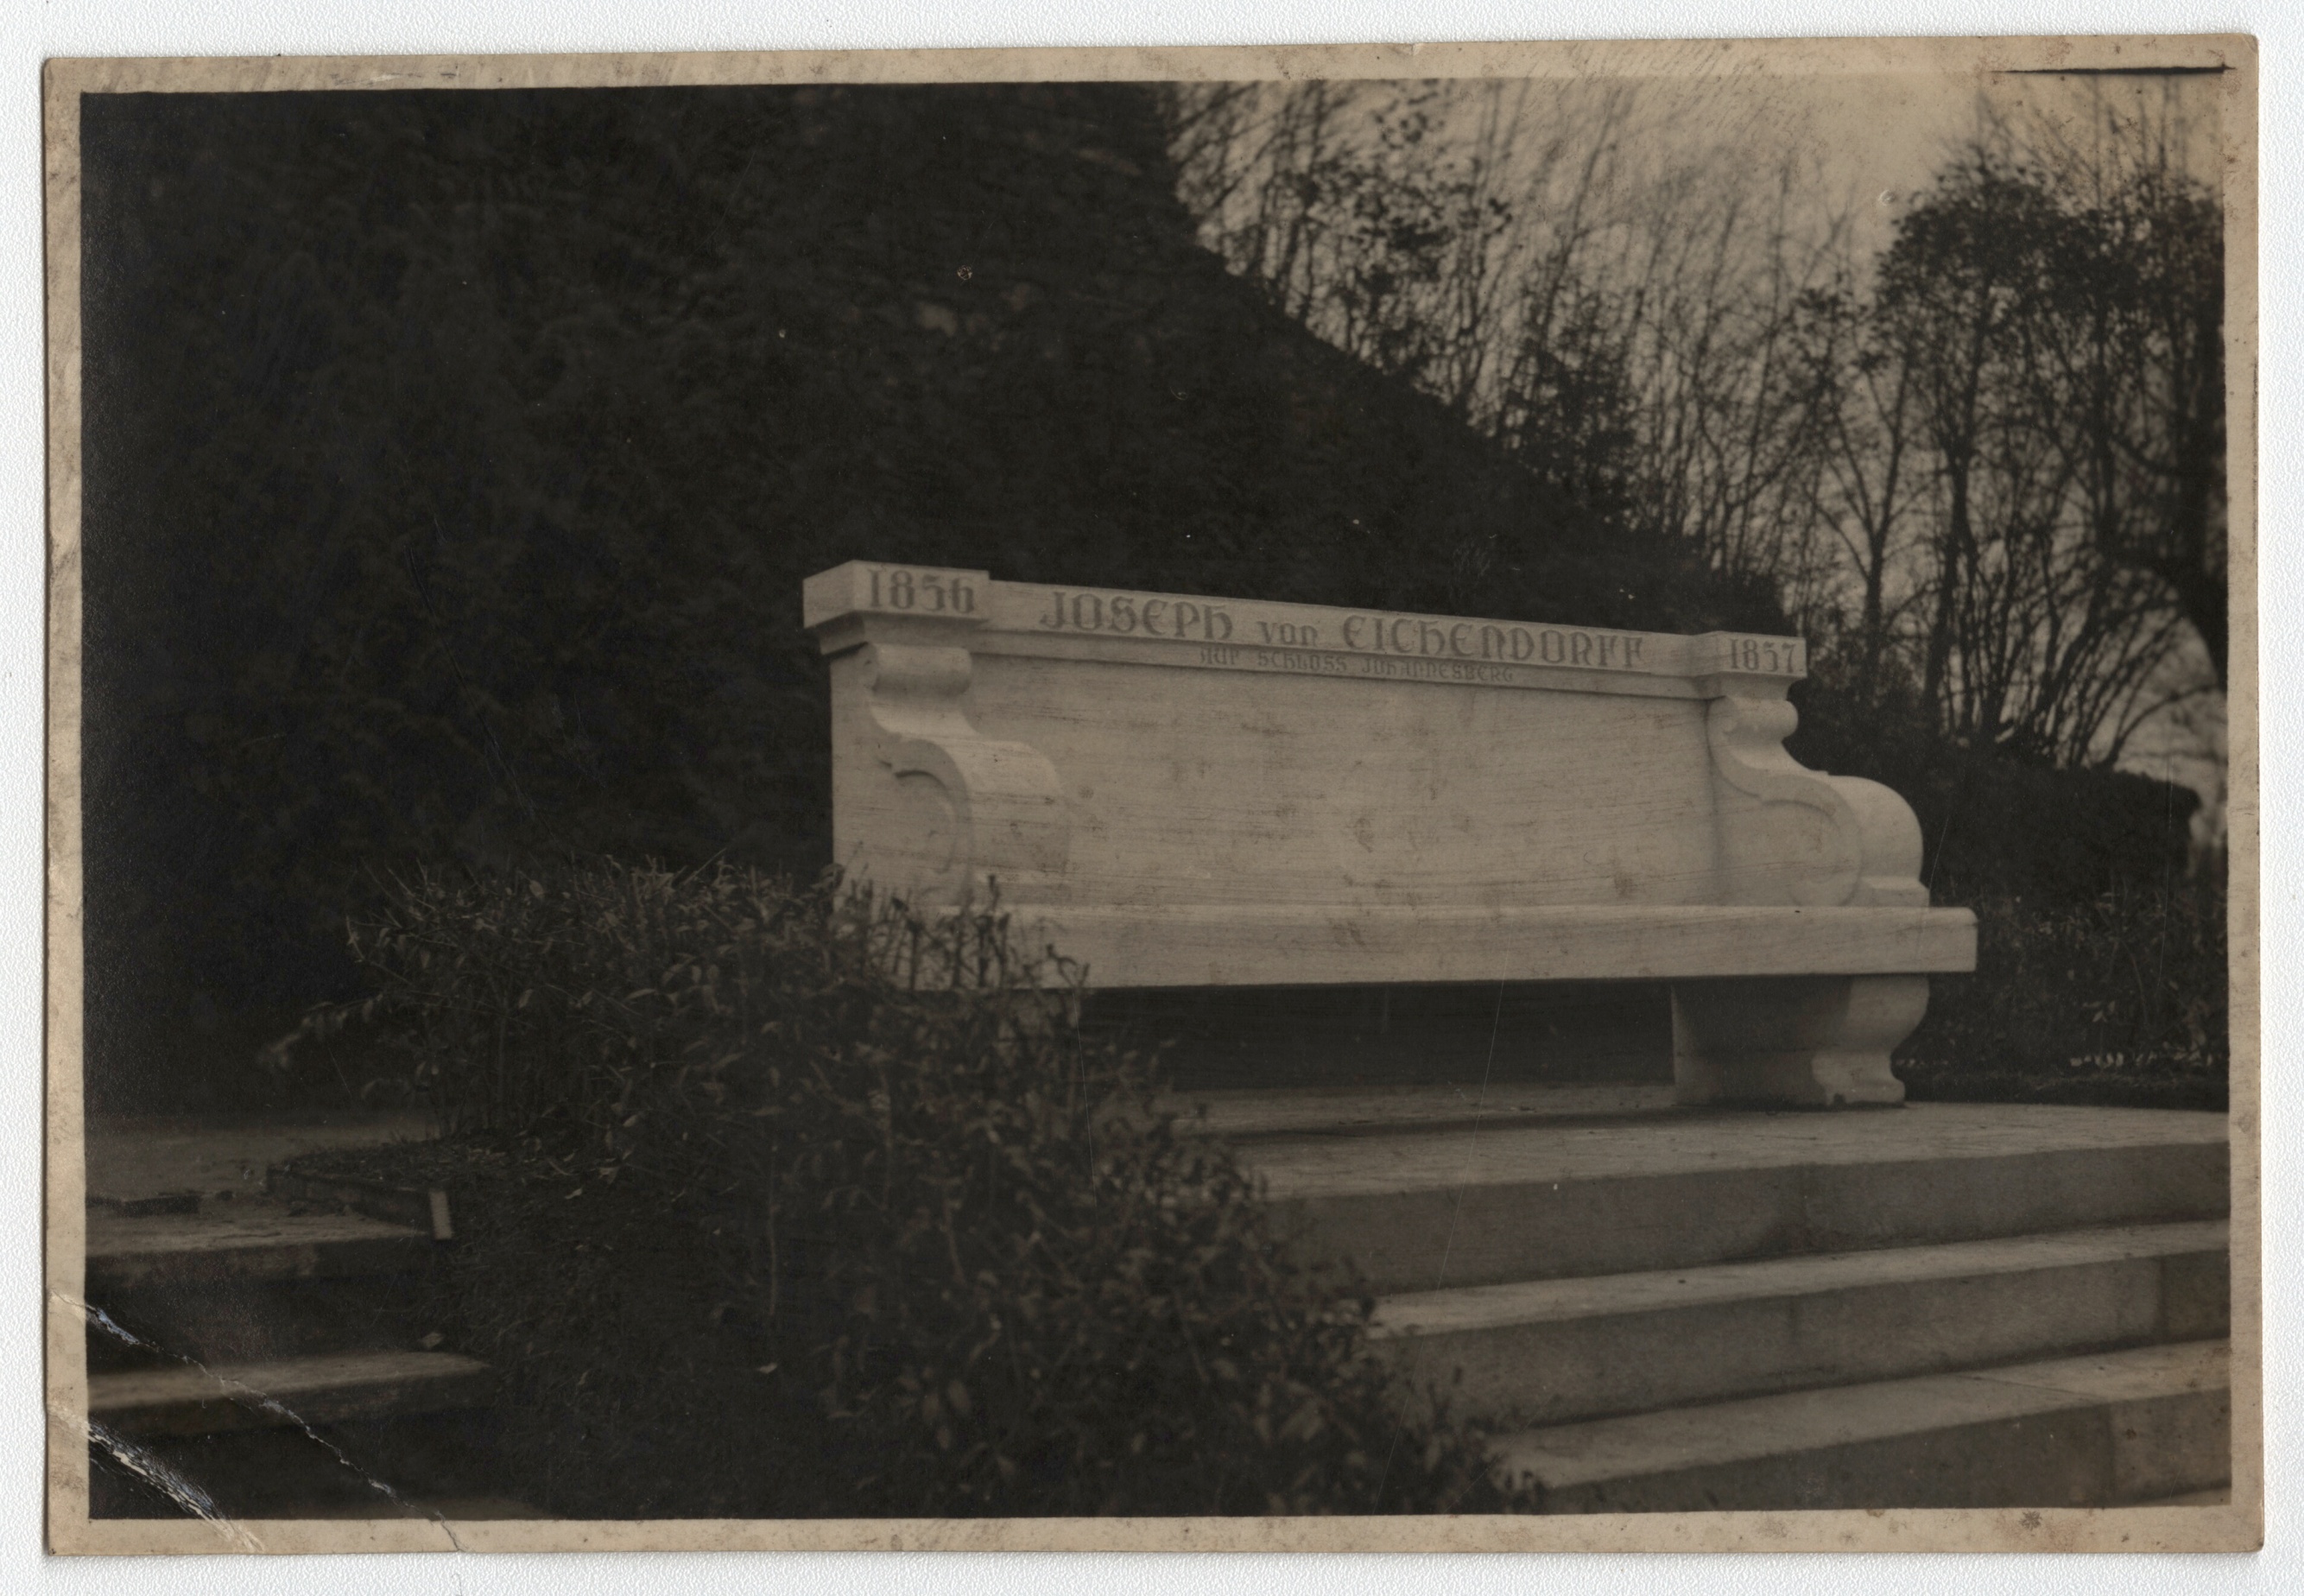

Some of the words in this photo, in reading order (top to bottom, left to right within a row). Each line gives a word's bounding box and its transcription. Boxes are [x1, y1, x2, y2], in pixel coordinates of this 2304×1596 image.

[867, 568, 975, 615] 1856
[1039, 591, 1234, 642] JOSEPH
[1341, 614, 1644, 669] EICHENDORFF
[1199, 648, 1240, 667] AUF
[1257, 649, 1348, 674] SCHLOSS
[1361, 656, 1514, 683] JOHANNESBERG
[1729, 637, 1797, 674] 1857
